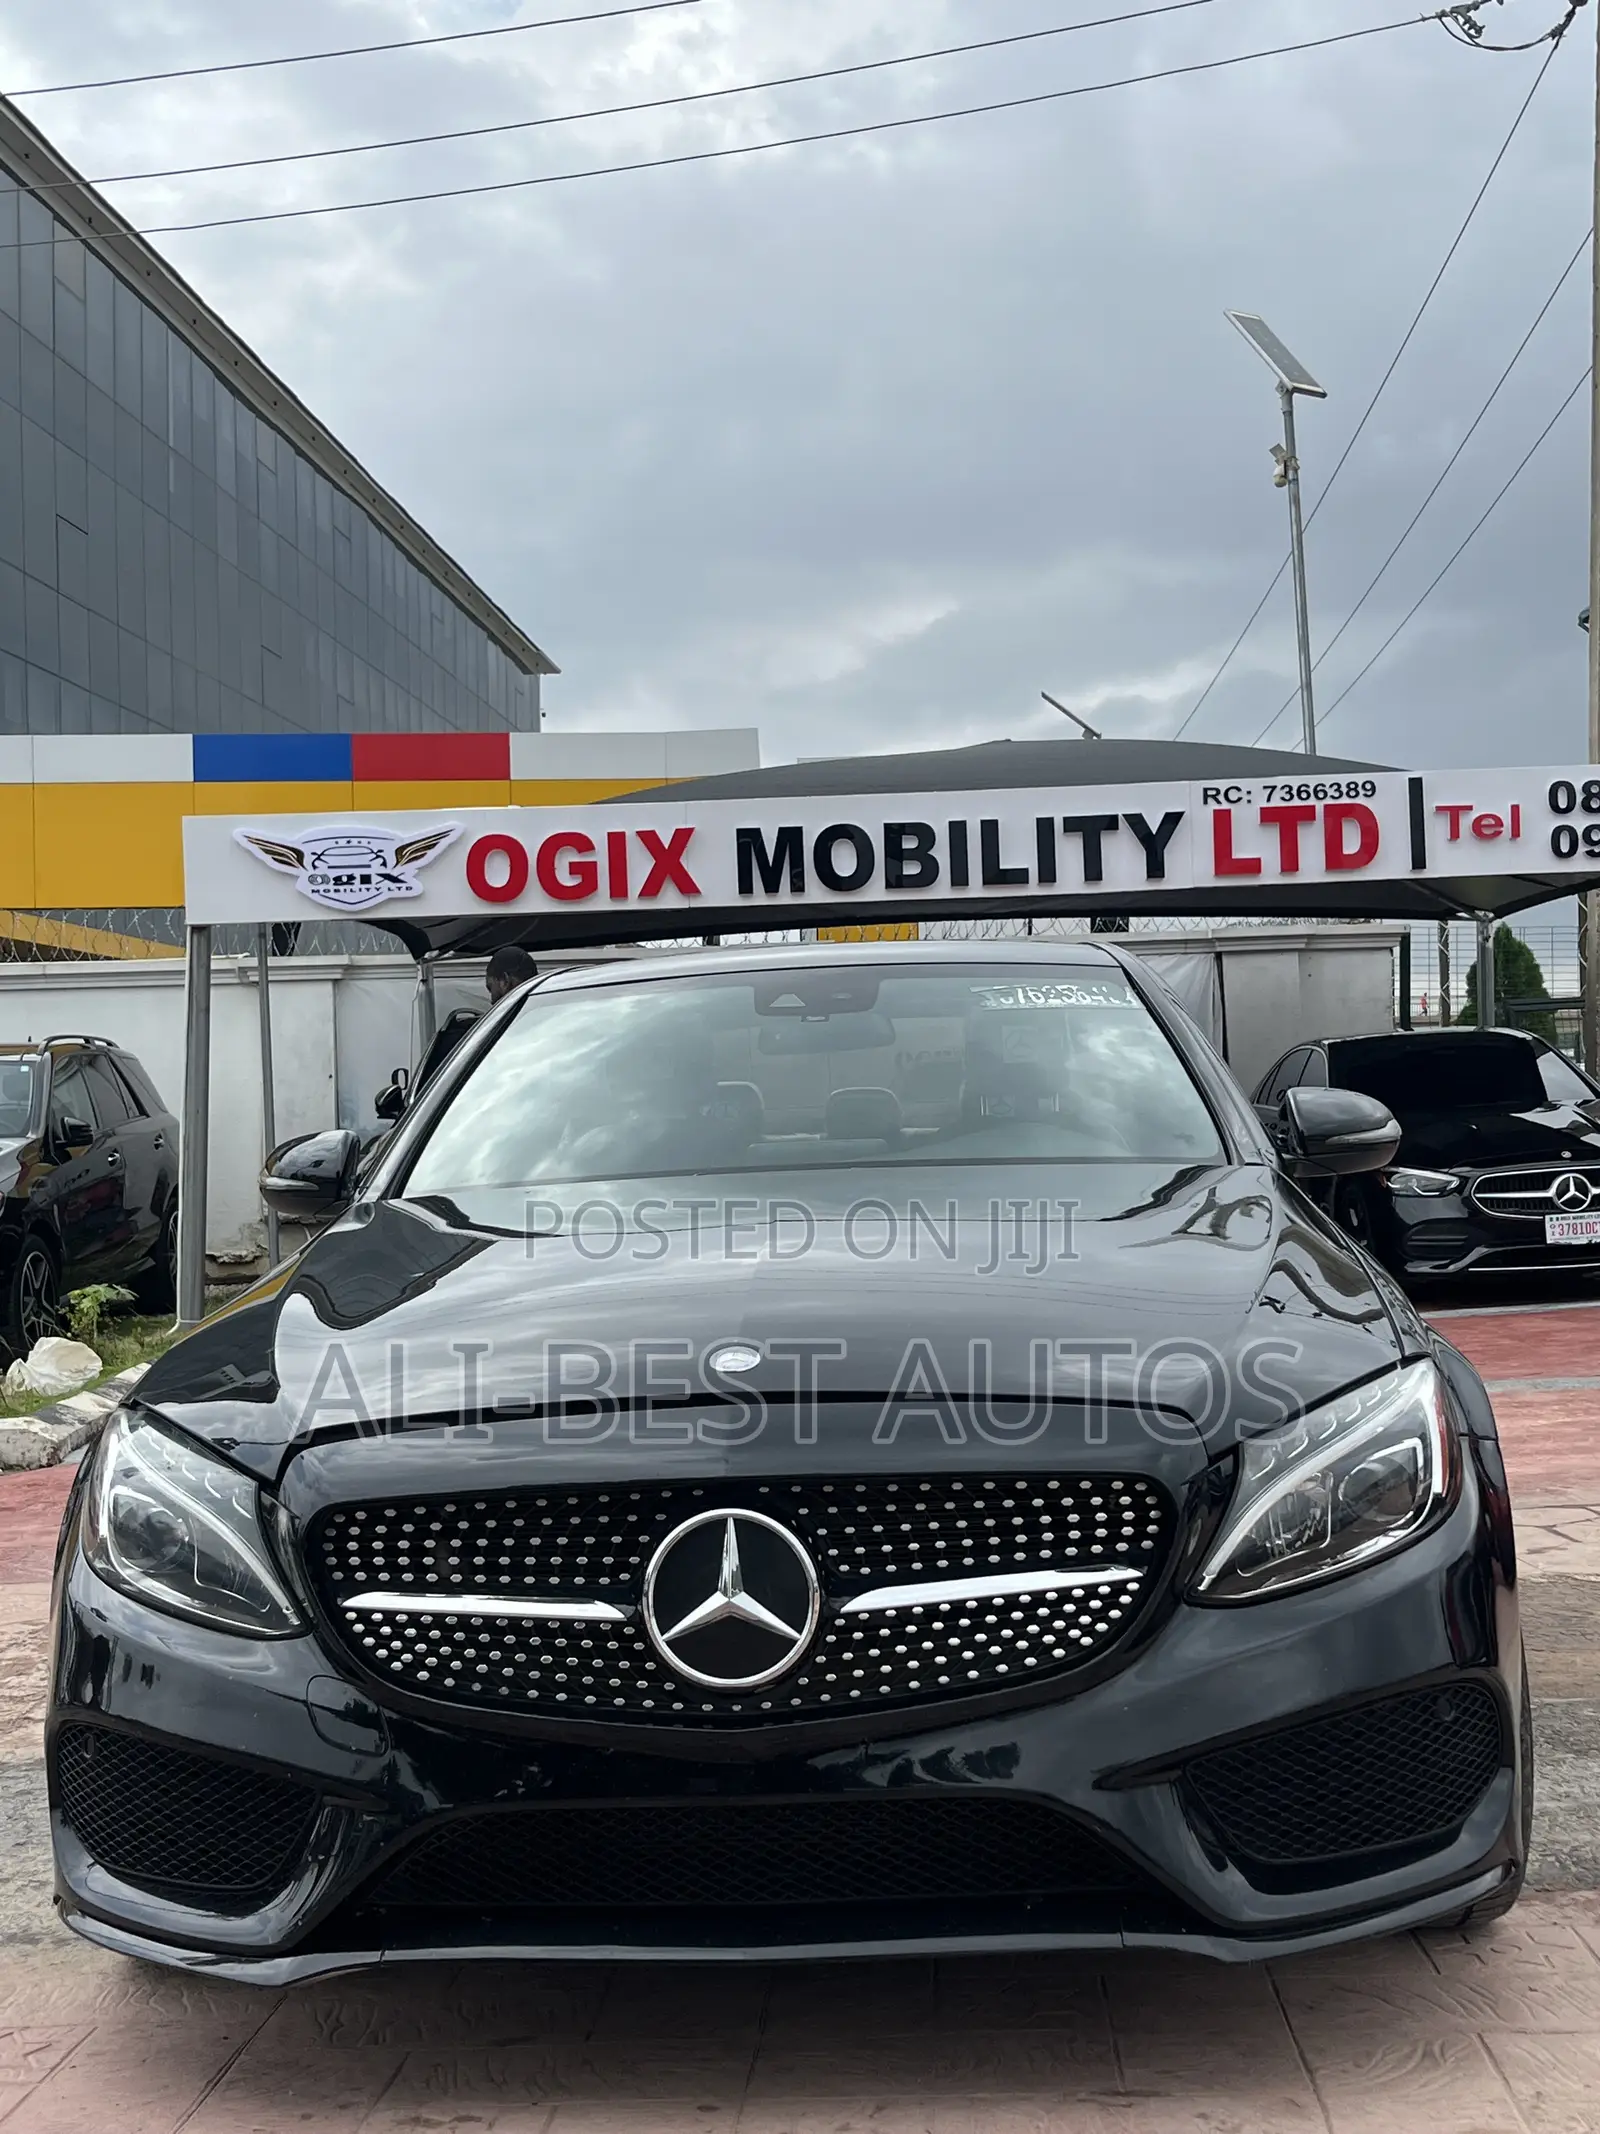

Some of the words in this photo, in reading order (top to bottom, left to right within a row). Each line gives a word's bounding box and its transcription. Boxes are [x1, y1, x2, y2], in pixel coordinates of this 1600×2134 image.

[1202, 785, 1252, 805] RC:
[1262, 779, 1376, 802] 7366389
[1435, 804, 1521, 841] Tel
[466, 827, 701, 903] OGIX
[735, 811, 1185, 896] MOBILITY
[1213, 803, 1379, 876] LTD
[311, 886, 381, 895] MOBILITY
[387, 885, 413, 893] LTD
